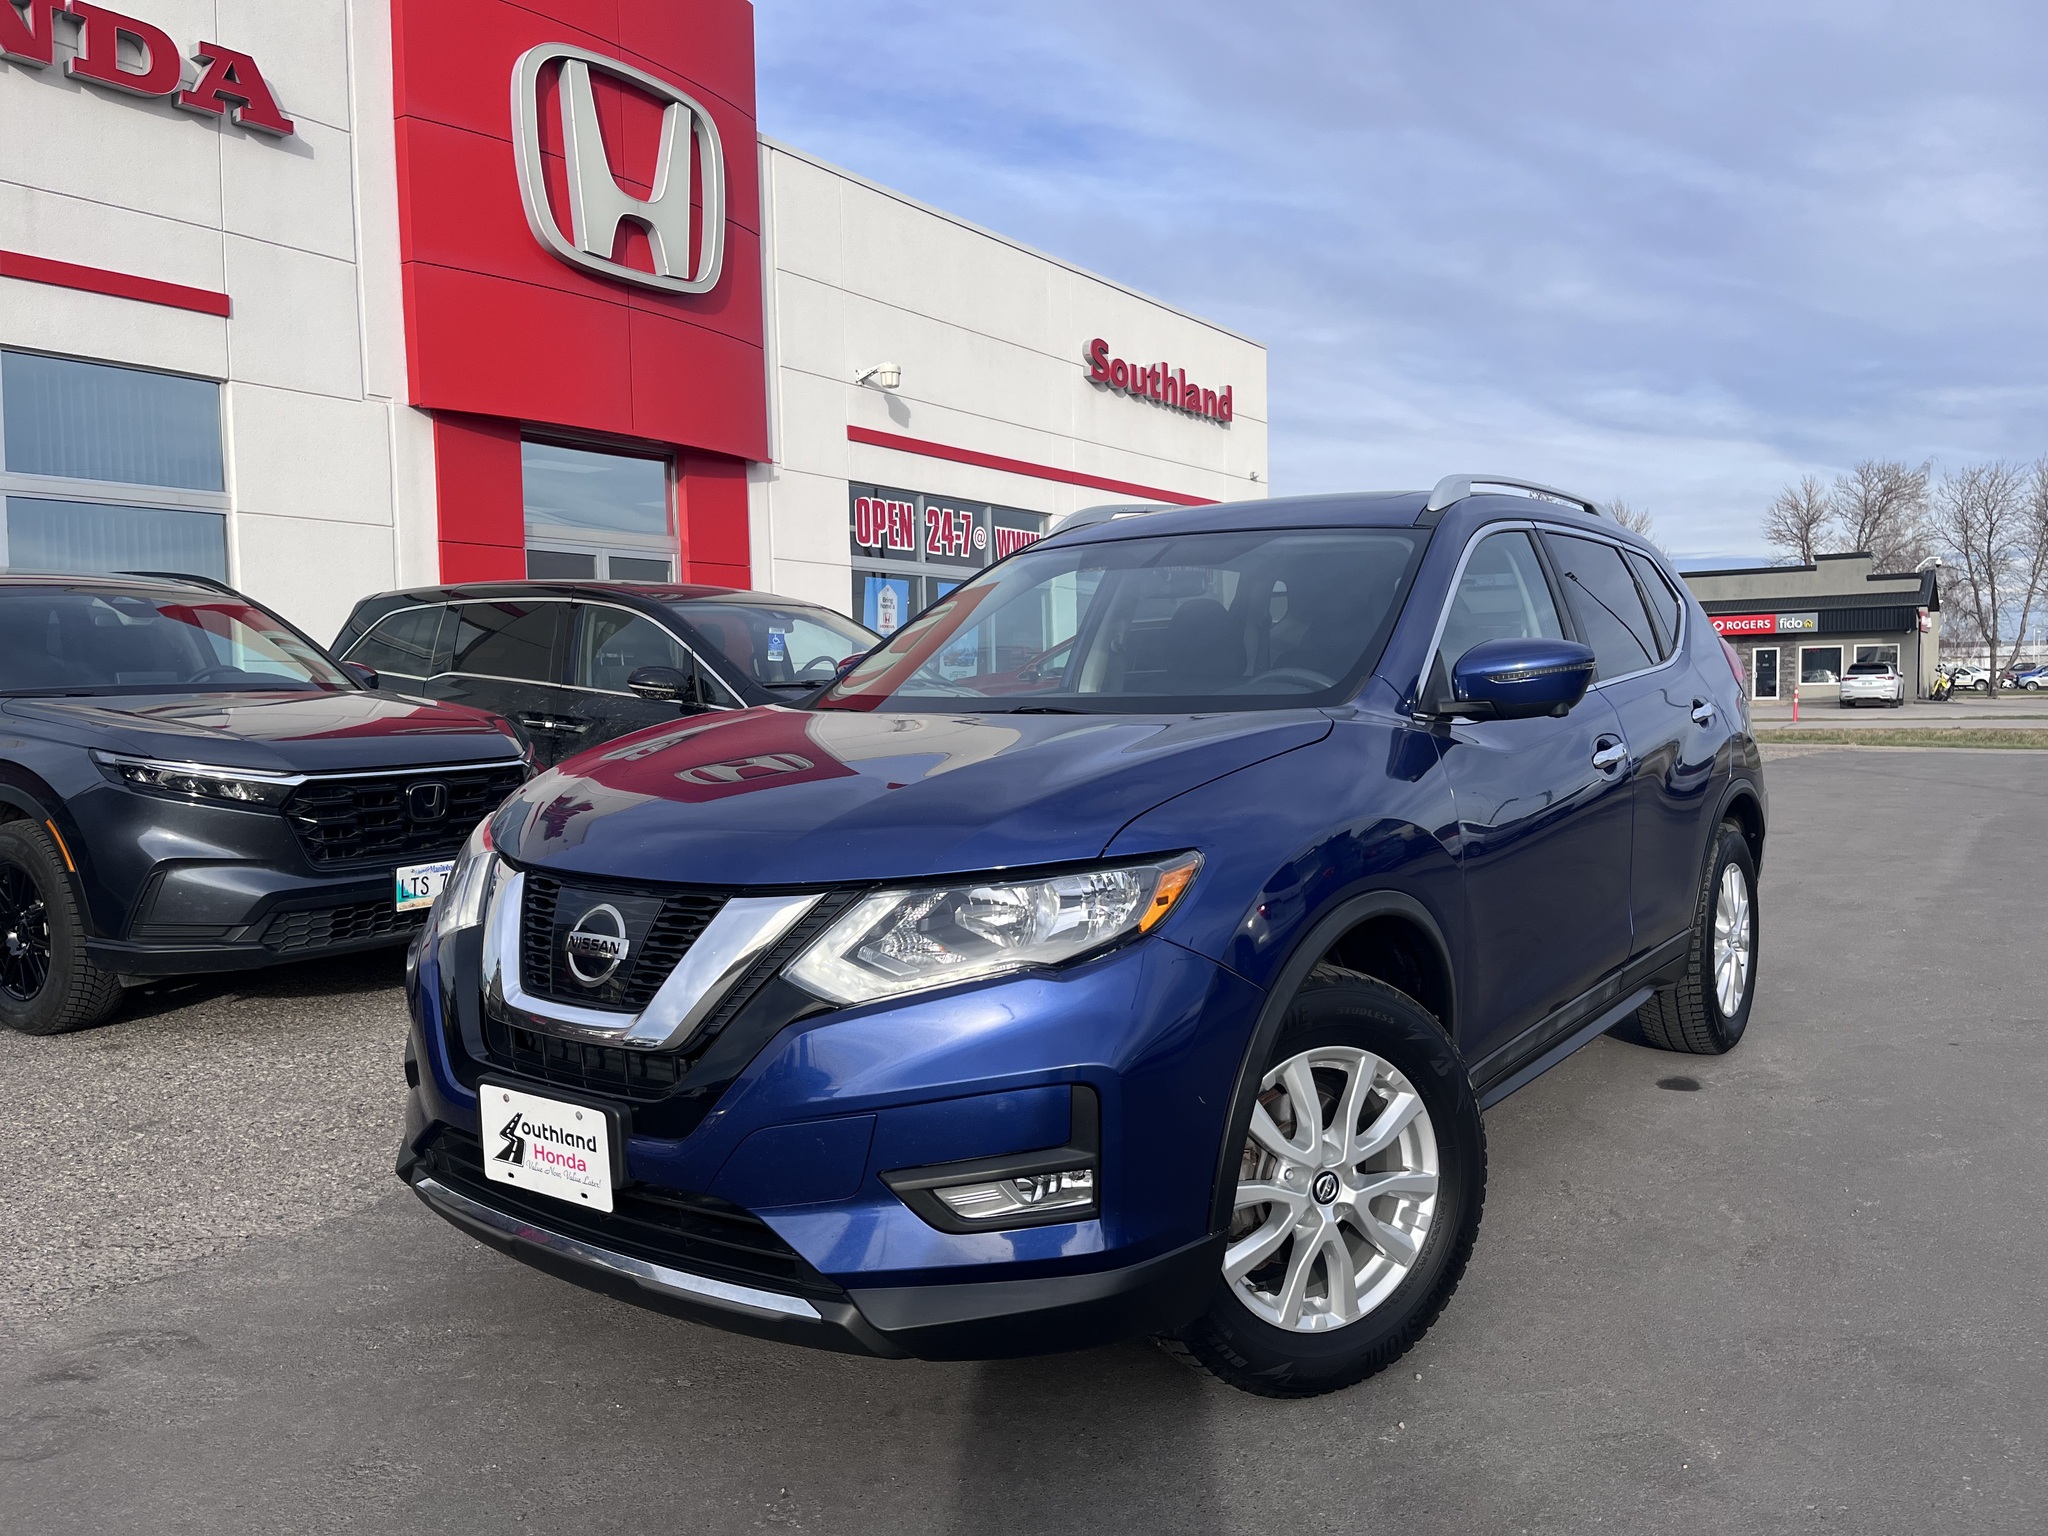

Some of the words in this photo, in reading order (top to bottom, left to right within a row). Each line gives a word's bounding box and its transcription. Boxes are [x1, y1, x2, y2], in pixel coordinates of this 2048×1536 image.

[1083, 338, 1233, 423] Southland
[855, 496, 915, 551] OPEN
[926, 506, 973, 558] 24-7
[973, 526, 987, 550] @
[1726, 619, 1771, 630] ROGERS
[1779, 617, 1803, 629] fido
[401, 876, 429, 899] LTS
[568, 935, 621, 955] NISSAN
[1336, 1006, 1396, 1025] STUDLESS
[533, 1143, 587, 1173] Honda
[526, 1159, 543, 1173] Value
[563, 1169, 581, 1184] Value
